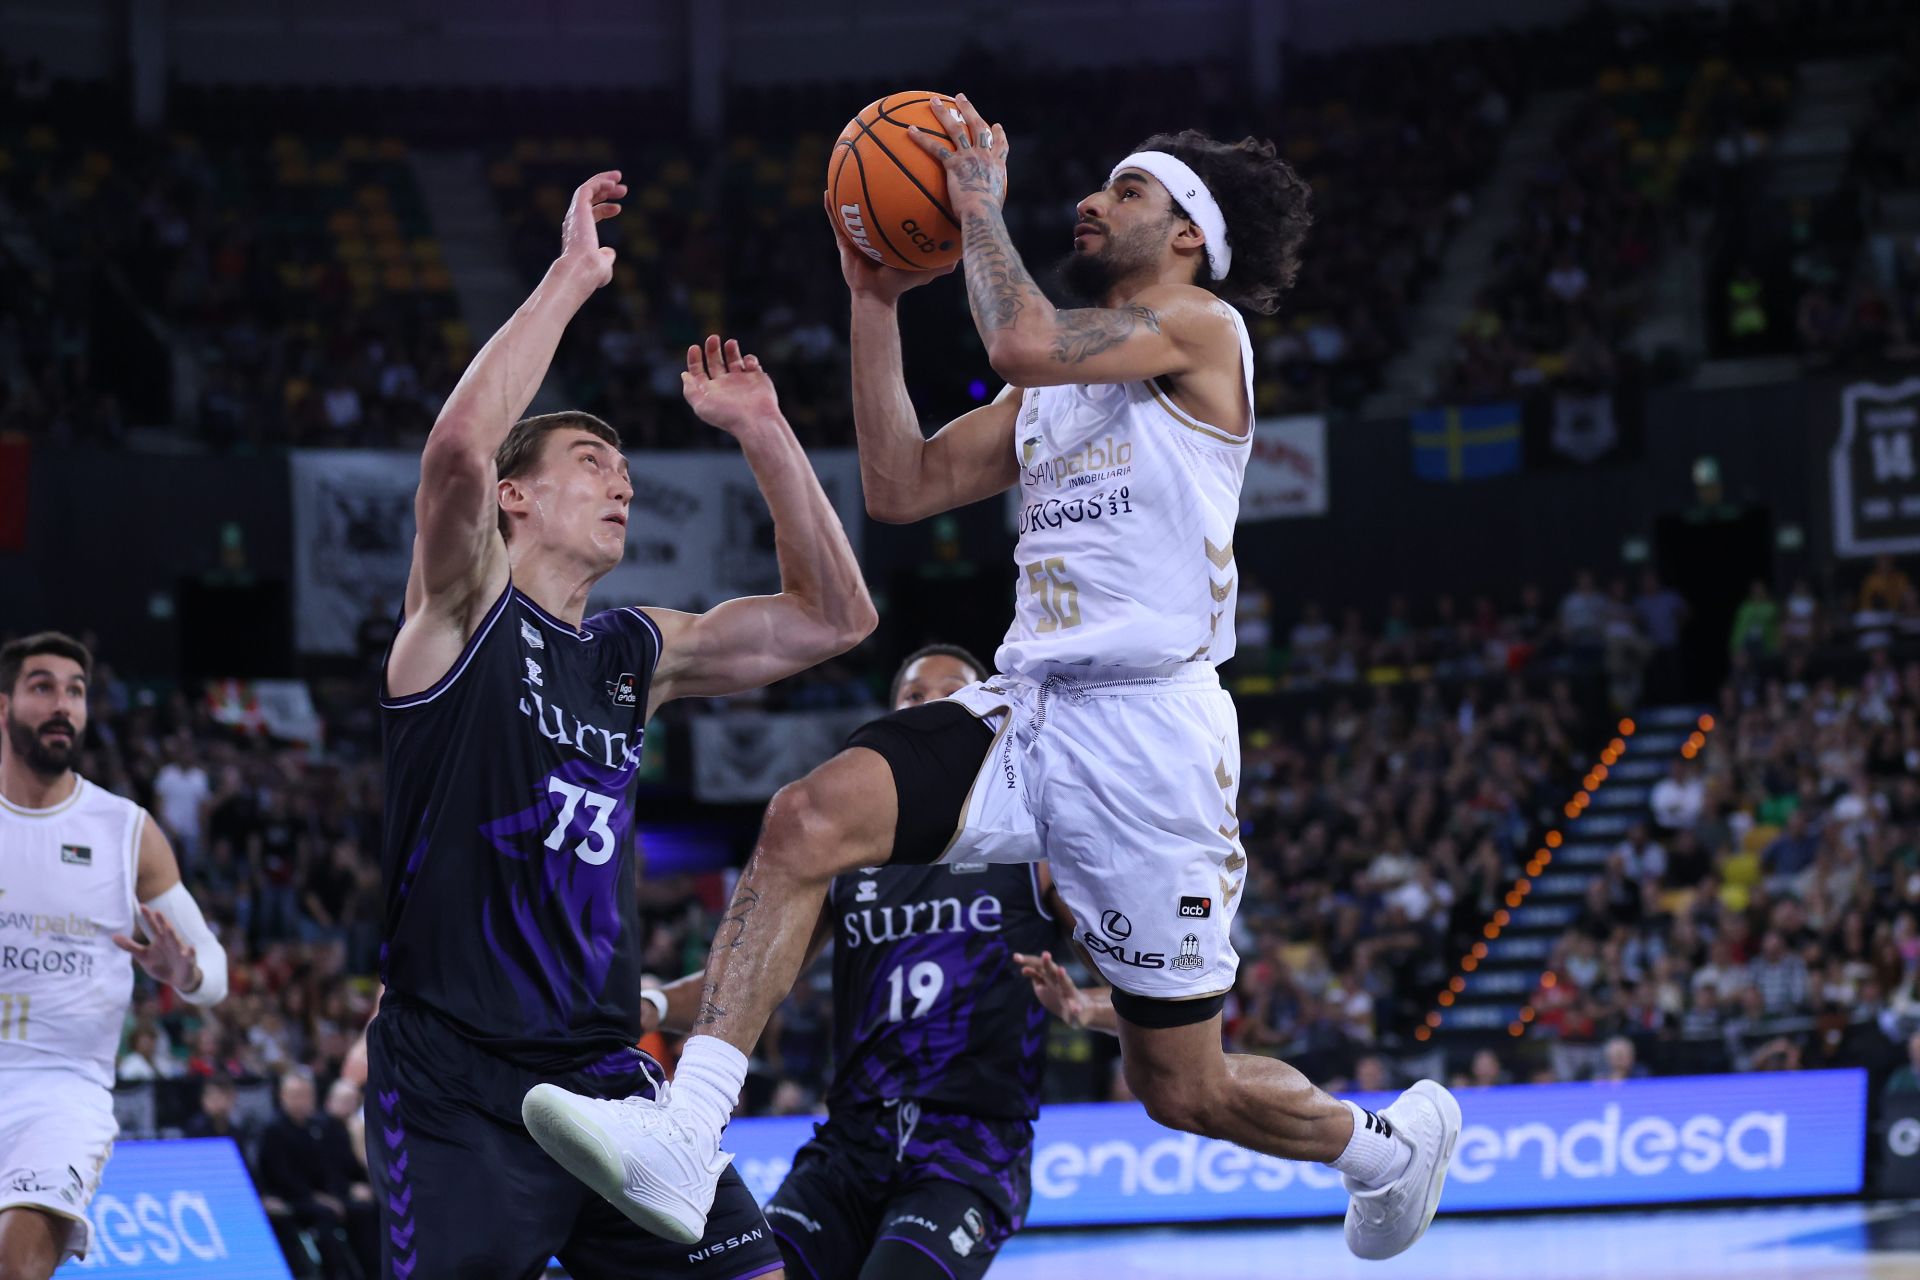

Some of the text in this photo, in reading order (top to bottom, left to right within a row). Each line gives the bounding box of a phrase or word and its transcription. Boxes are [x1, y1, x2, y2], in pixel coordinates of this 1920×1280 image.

[901, 218, 936, 254] acb
[1068, 466, 1132, 488] INMOBILIARIA
[1108, 501, 1133, 515] 31
[1025, 556, 1082, 634] 56
[543, 775, 619, 866] 73
[844, 894, 1002, 948] surne
[1181, 905, 1204, 916] acb
[887, 960, 945, 1024] 19
[1448, 1103, 1787, 1183] endesa
[688, 1228, 763, 1264] NISSAN
